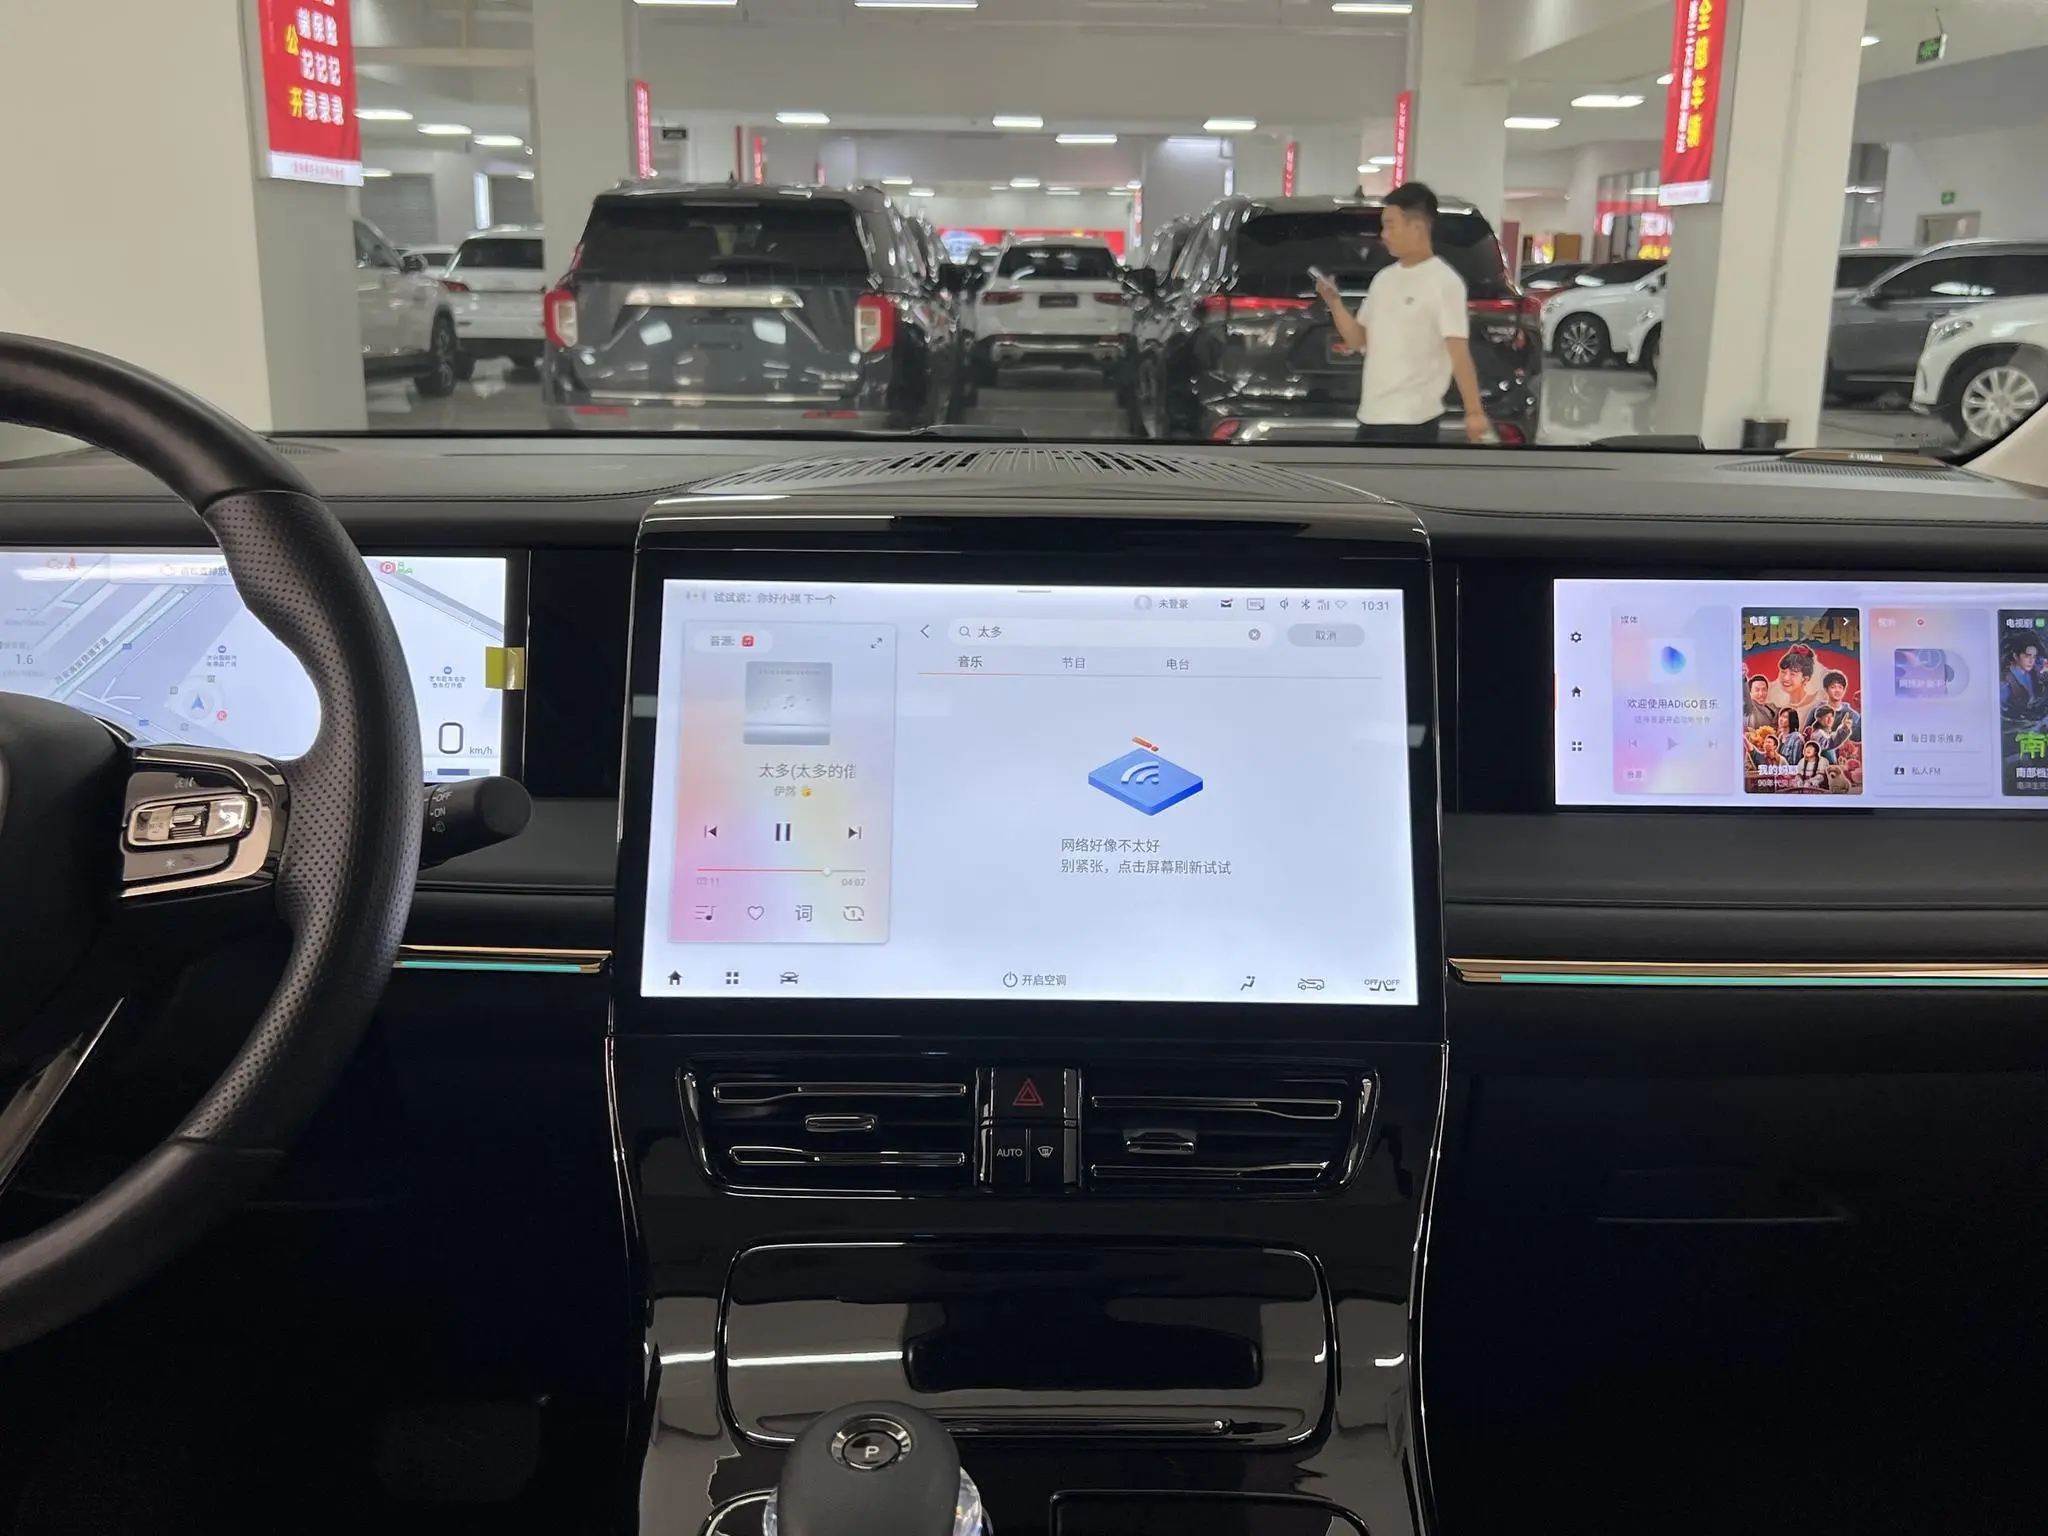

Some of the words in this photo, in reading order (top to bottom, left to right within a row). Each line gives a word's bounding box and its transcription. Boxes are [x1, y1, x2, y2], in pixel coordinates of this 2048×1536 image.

[1159, 598, 1189, 610] 未登录
[1361, 600, 1390, 612] 10:31
[1749, 615, 1768, 626] 电影
[2006, 618, 2033, 629] 电视剧
[977, 626, 1003, 639] 太多
[15, 653, 34, 666] 1.6
[957, 655, 984, 669] 音乐
[1062, 657, 1087, 670] 节目
[1166, 658, 1190, 671] 电台
[1627, 698, 1719, 710] 欢迎使用ADiGO音乐
[438, 721, 464, 755] 0
[469, 746, 493, 755] km/h
[1911, 766, 1942, 776] 私人FM
[2015, 767, 2048, 778] 南部档
[1061, 838, 1161, 854] 网络好像不太好
[1061, 859, 1232, 876] 别紧张，点击屏幕刷新试试
[841, 878, 866, 888] 04:07
[795, 904, 813, 922] 词
[1021, 973, 1067, 988] 开启空调
[1364, 978, 1379, 986] OFF
[1386, 978, 1400, 987] OFF
[996, 1148, 1023, 1158] AUTO
[865, 1445, 880, 1459] P
